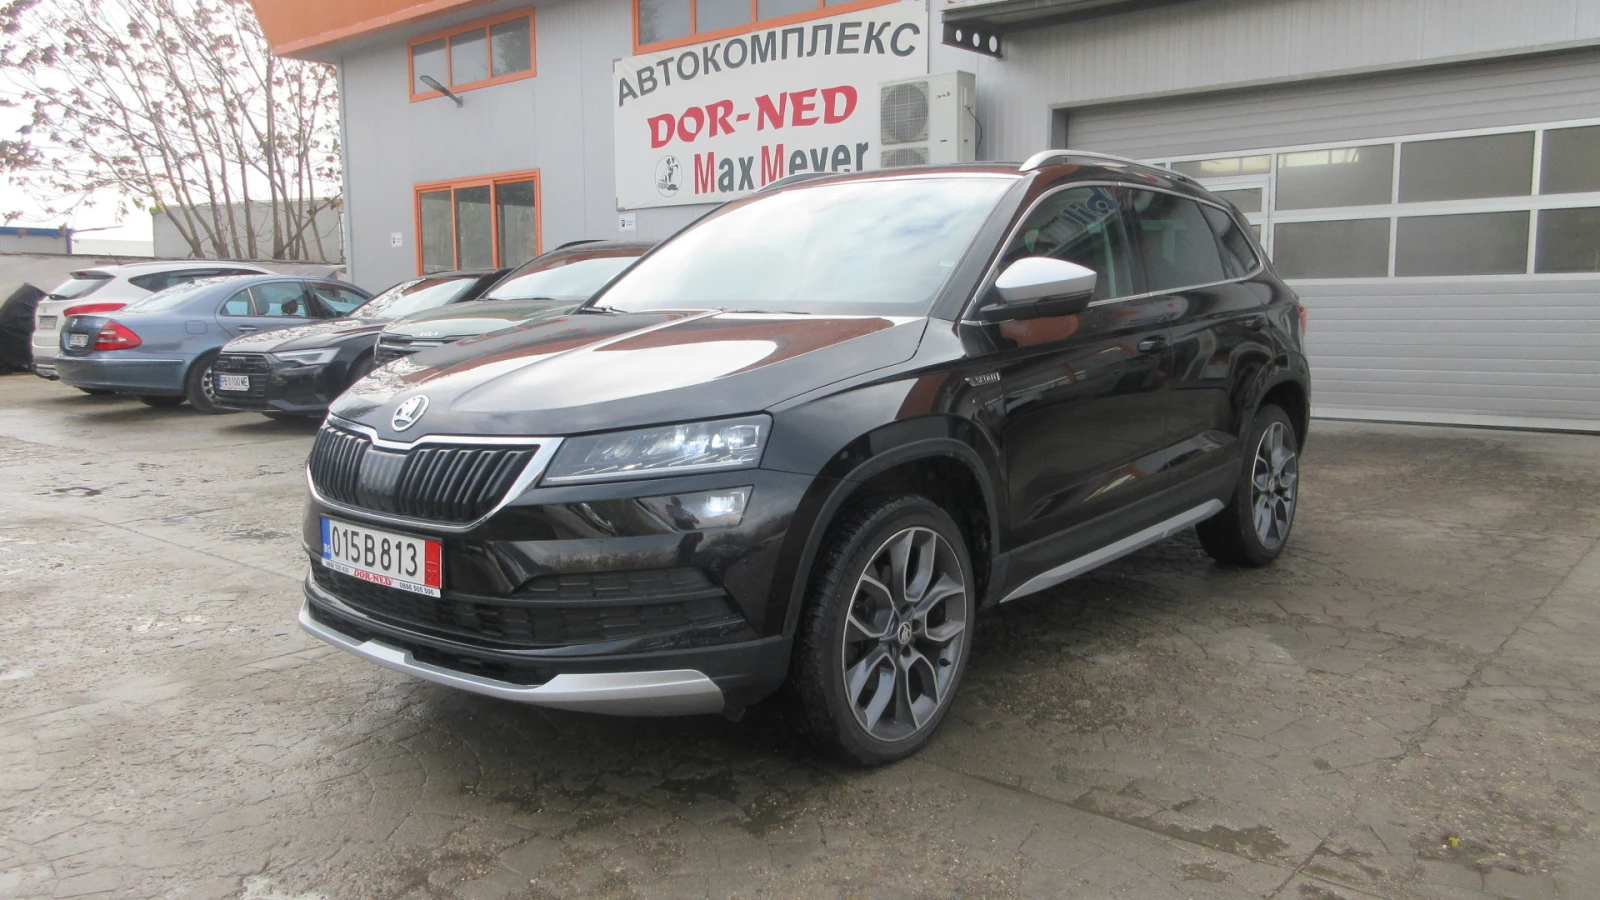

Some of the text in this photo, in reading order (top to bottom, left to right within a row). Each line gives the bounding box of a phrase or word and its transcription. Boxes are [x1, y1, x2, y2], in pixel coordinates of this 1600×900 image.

[618, 21, 921, 107] АВТОКОМПЛЕКС
[647, 85, 858, 149] DOR-NED
[332, 526, 418, 577] 015B813
[353, 568, 392, 586] DOR-NED
